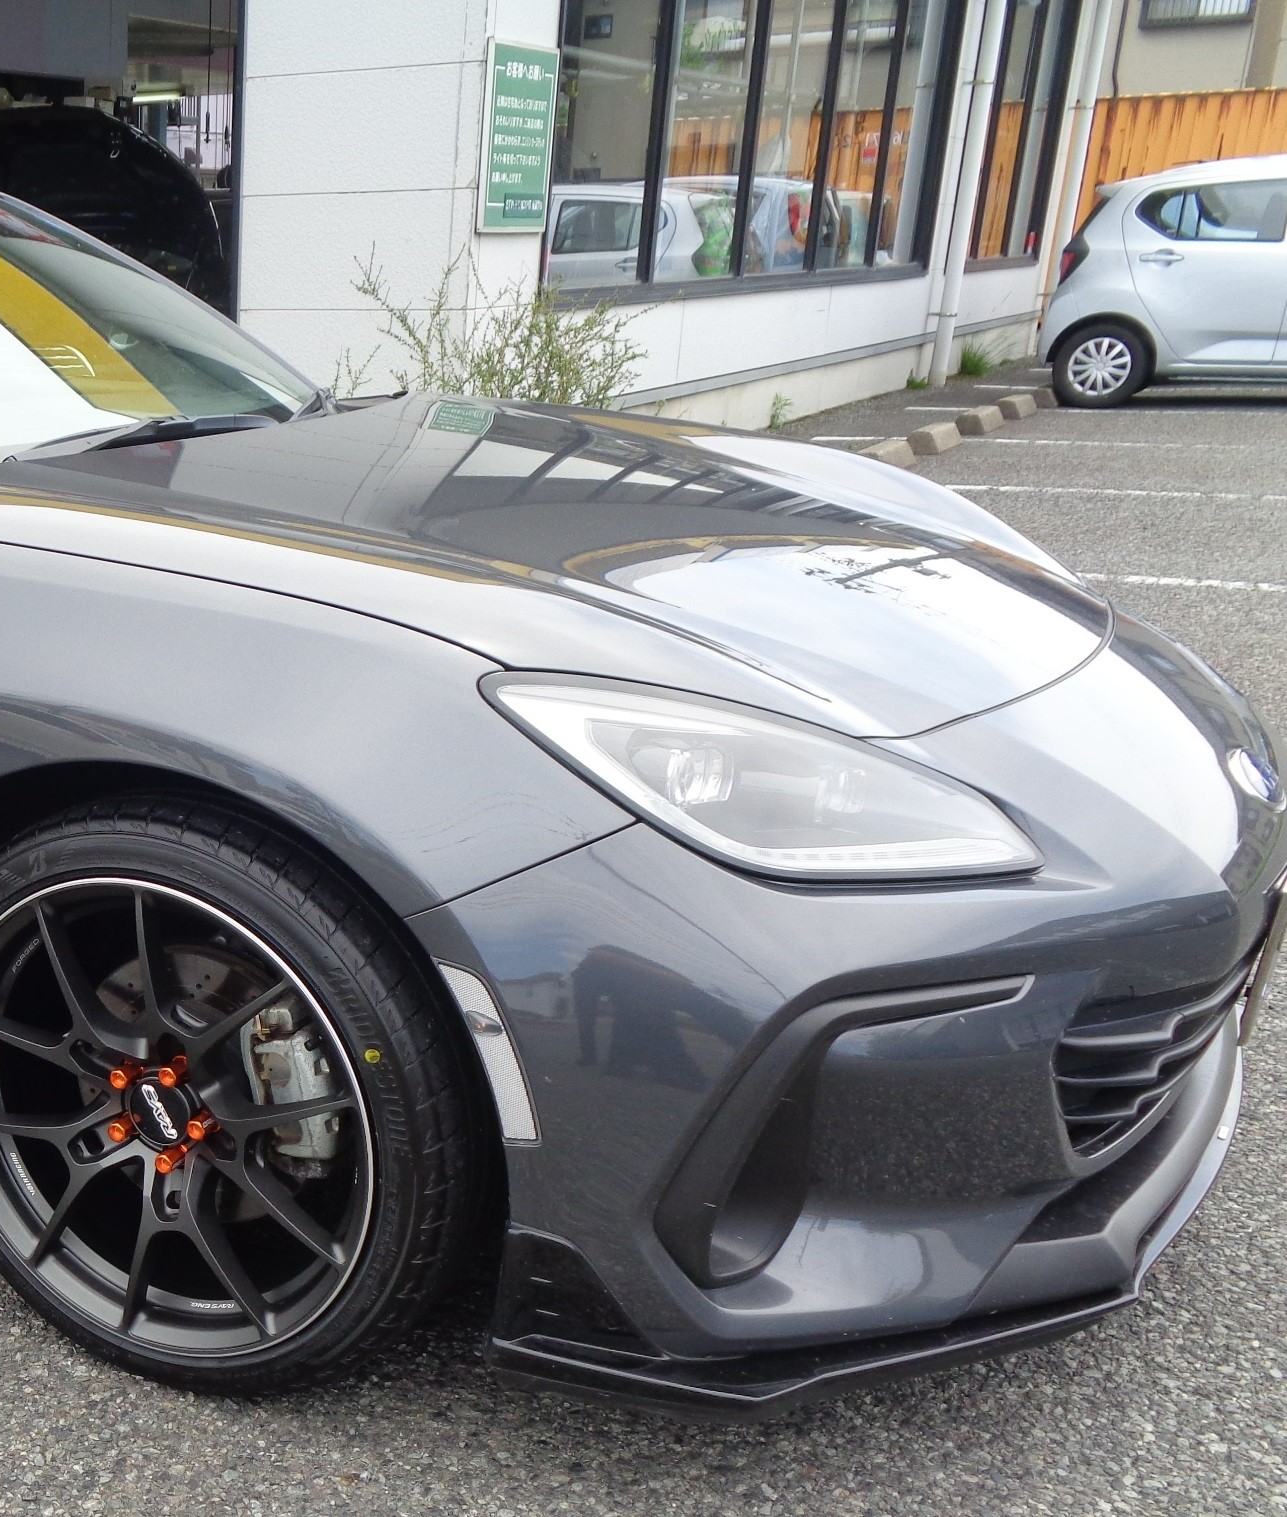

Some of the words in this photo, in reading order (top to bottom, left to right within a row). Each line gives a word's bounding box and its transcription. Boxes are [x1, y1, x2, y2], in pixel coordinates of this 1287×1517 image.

[505, 61, 545, 81] お客様へお願い
[11, 938, 40, 974] FORGED
[141, 1083, 178, 1140] RAYS
